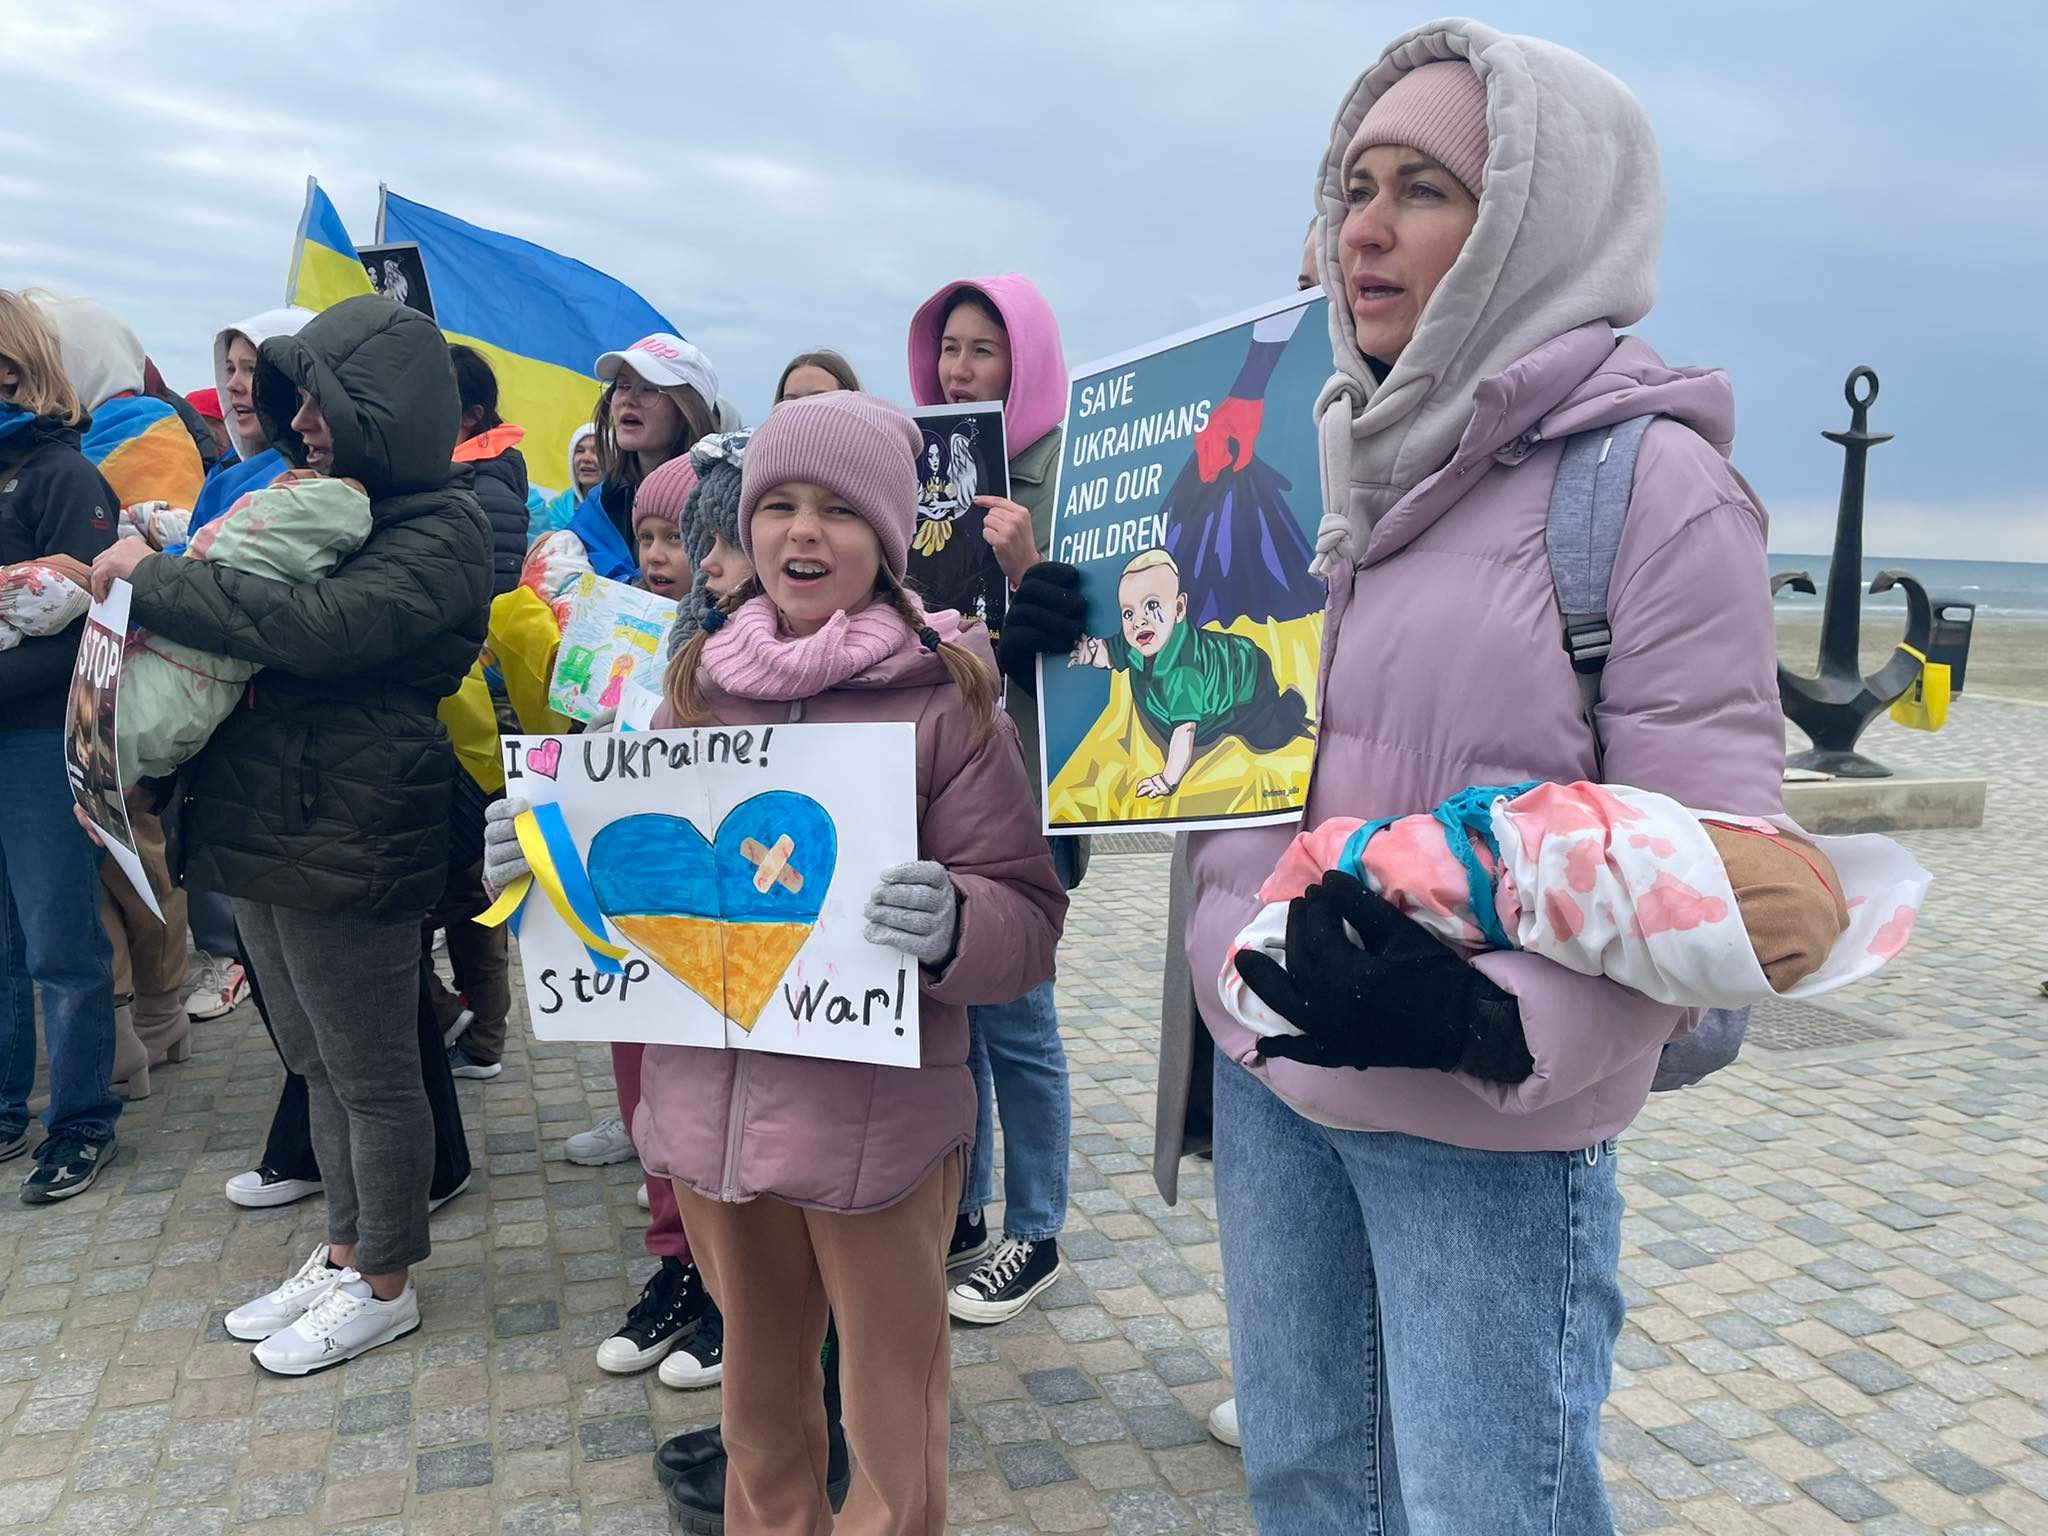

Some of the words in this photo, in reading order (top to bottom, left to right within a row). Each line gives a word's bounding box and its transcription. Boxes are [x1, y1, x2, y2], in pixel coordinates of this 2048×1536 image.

[1079, 372, 1136, 418] SAVE
[1072, 400, 1212, 467] UKRAINIANS
[1064, 476, 1110, 518] AND
[1114, 463, 1163, 504] OUR
[1059, 512, 1168, 564] CHILDREN
[79, 625, 120, 689] STOP
[505, 741, 524, 779] I
